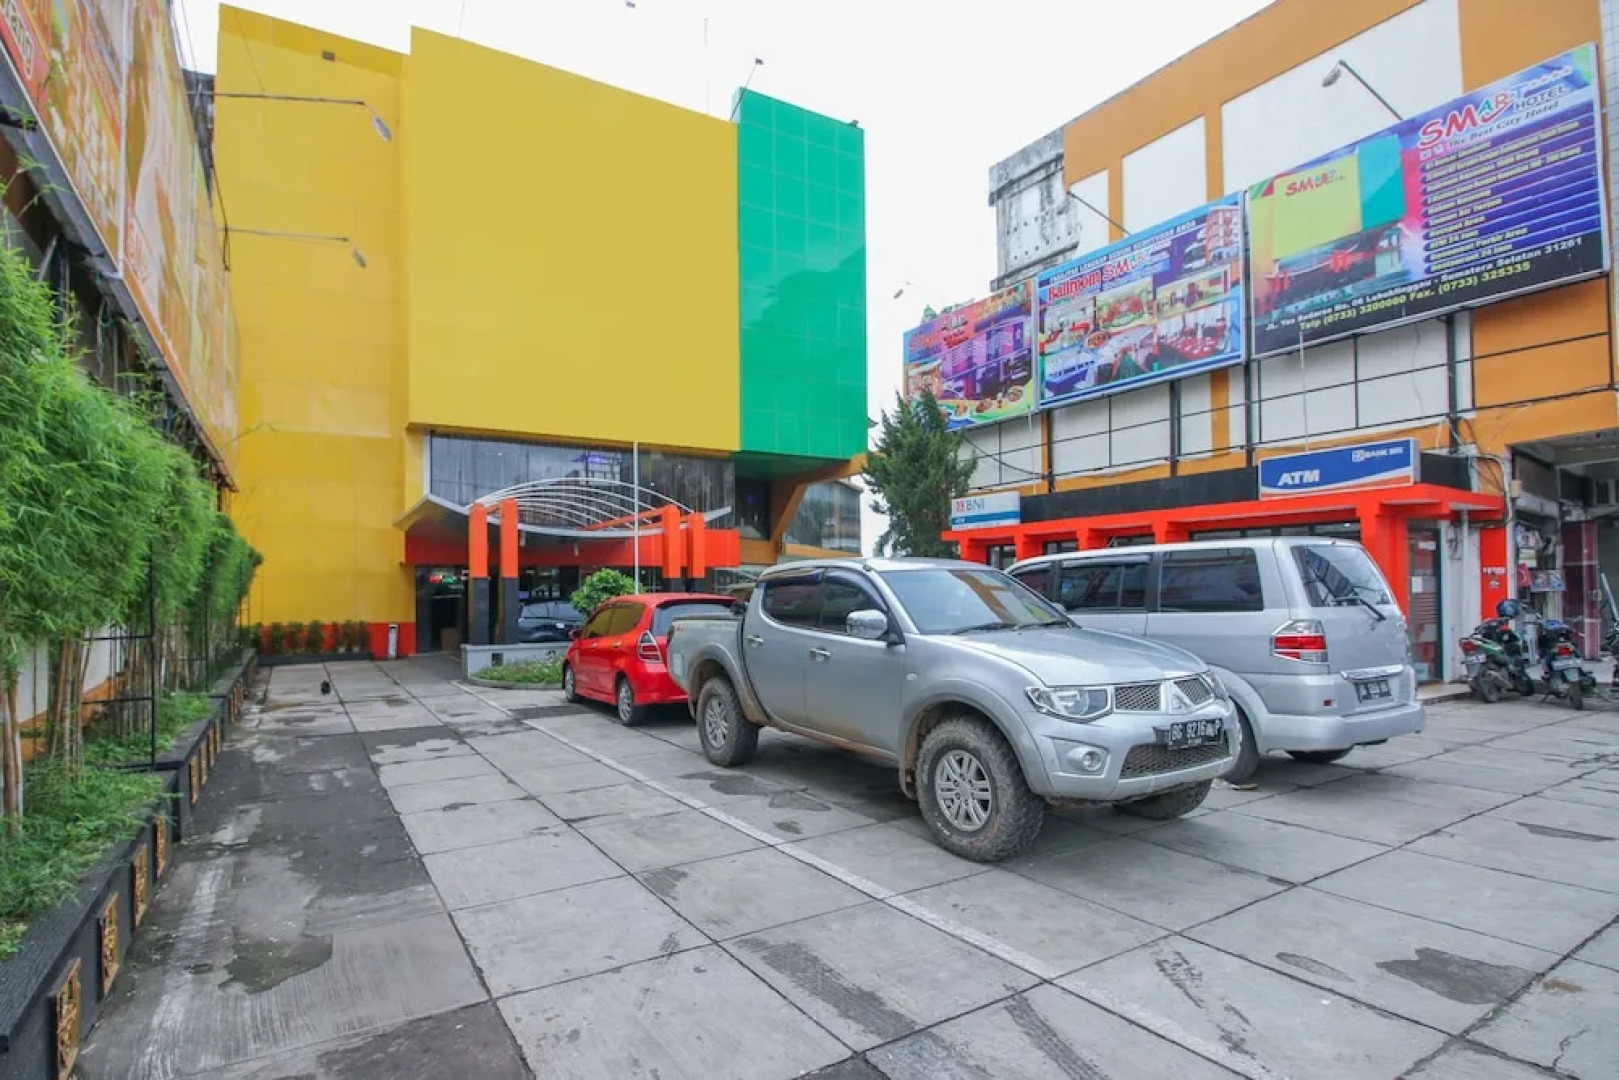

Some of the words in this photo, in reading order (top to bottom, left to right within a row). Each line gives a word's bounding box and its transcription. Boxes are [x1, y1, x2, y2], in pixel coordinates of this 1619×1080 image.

[1514, 85, 1567, 111] HOTEL
[1418, 84, 1524, 147] SMART
[1440, 263, 1494, 283] Sumatera
[1496, 249, 1541, 266] Selatan
[1438, 276, 1479, 295] (0733)
[1364, 448, 1388, 459] BANK
[1277, 469, 1321, 487] ATM
[966, 498, 985, 511] BNI
